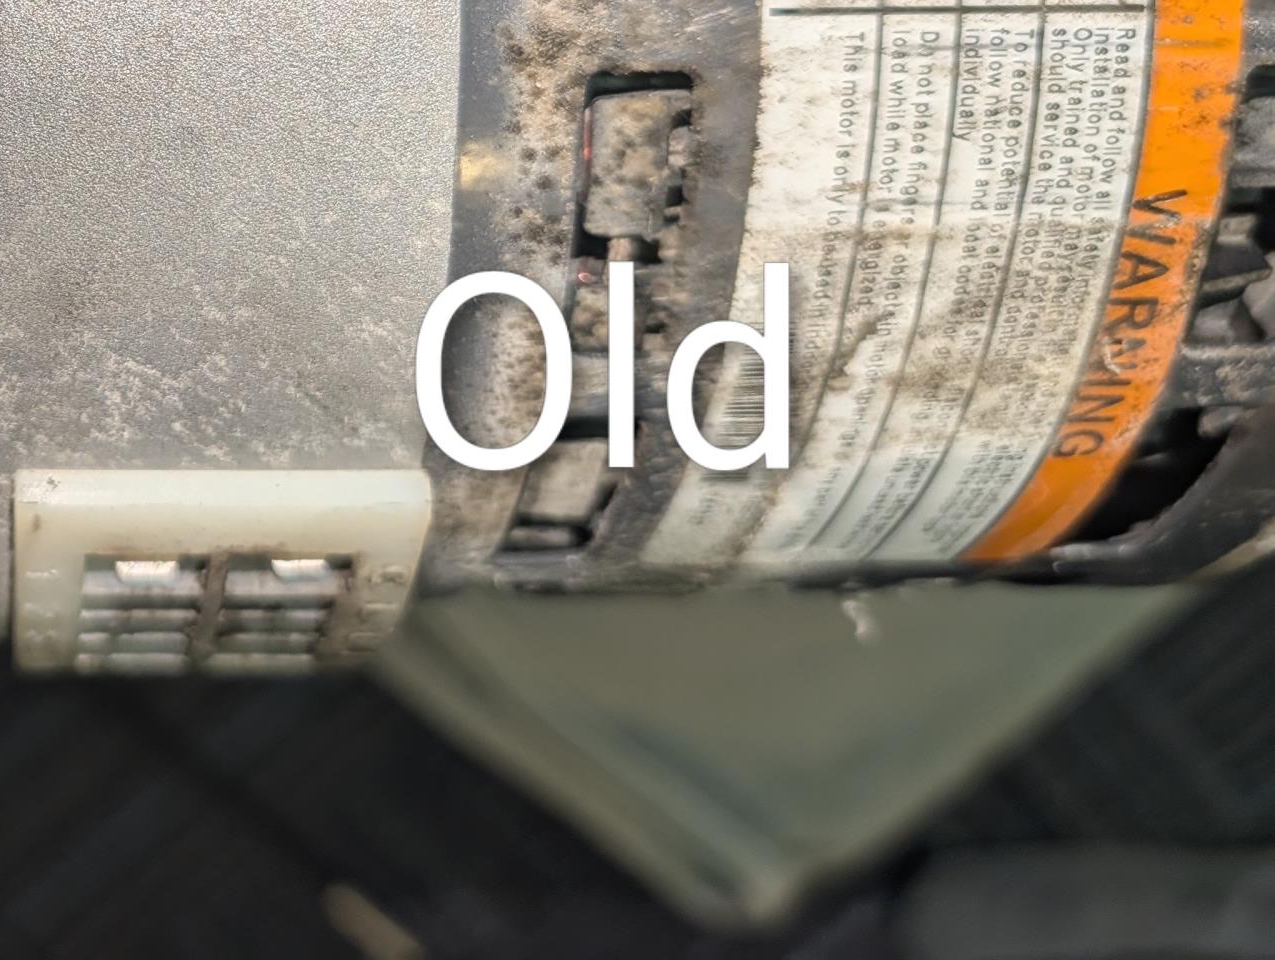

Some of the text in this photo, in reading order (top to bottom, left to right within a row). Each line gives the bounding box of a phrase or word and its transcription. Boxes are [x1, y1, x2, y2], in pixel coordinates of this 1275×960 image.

[842, 32, 864, 73] This
[890, 31, 911, 73] load
[917, 31, 939, 57] Do
[987, 28, 1009, 87] follow
[1013, 29, 1034, 52] To
[1047, 28, 1069, 94] should
[1065, 28, 1093, 72] Only
[1114, 28, 1136, 78] Read
[915, 64, 937, 96] not
[952, 28, 982, 141] individually
[1007, 60, 1032, 128] reduce
[1087, 27, 1111, 137] installation
[1108, 86, 1128, 121] and
[836, 80, 859, 137] motor
[884, 81, 906, 131] while
[910, 102, 934, 154] place
[1062, 81, 1088, 148] trained
[835, 144, 857, 158] is
[977, 95, 1006, 172] national
[1037, 102, 1060, 172] service
[1083, 144, 1099, 162] of
[1098, 128, 1125, 184] follow
[825, 166, 852, 205] only
[877, 138, 900, 193] motor
[993, 137, 1021, 217] potential
[1055, 156, 1076, 189] and
[899, 161, 925, 225] fingers
[970, 179, 990, 210] and
[1031, 179, 1055, 205] the
[1072, 166, 1094, 219] motor
[1093, 191, 1112, 211] all
[827, 210, 844, 226] to
[1019, 212, 1044, 262] motor
[1053, 190, 1188, 458] WARNING
